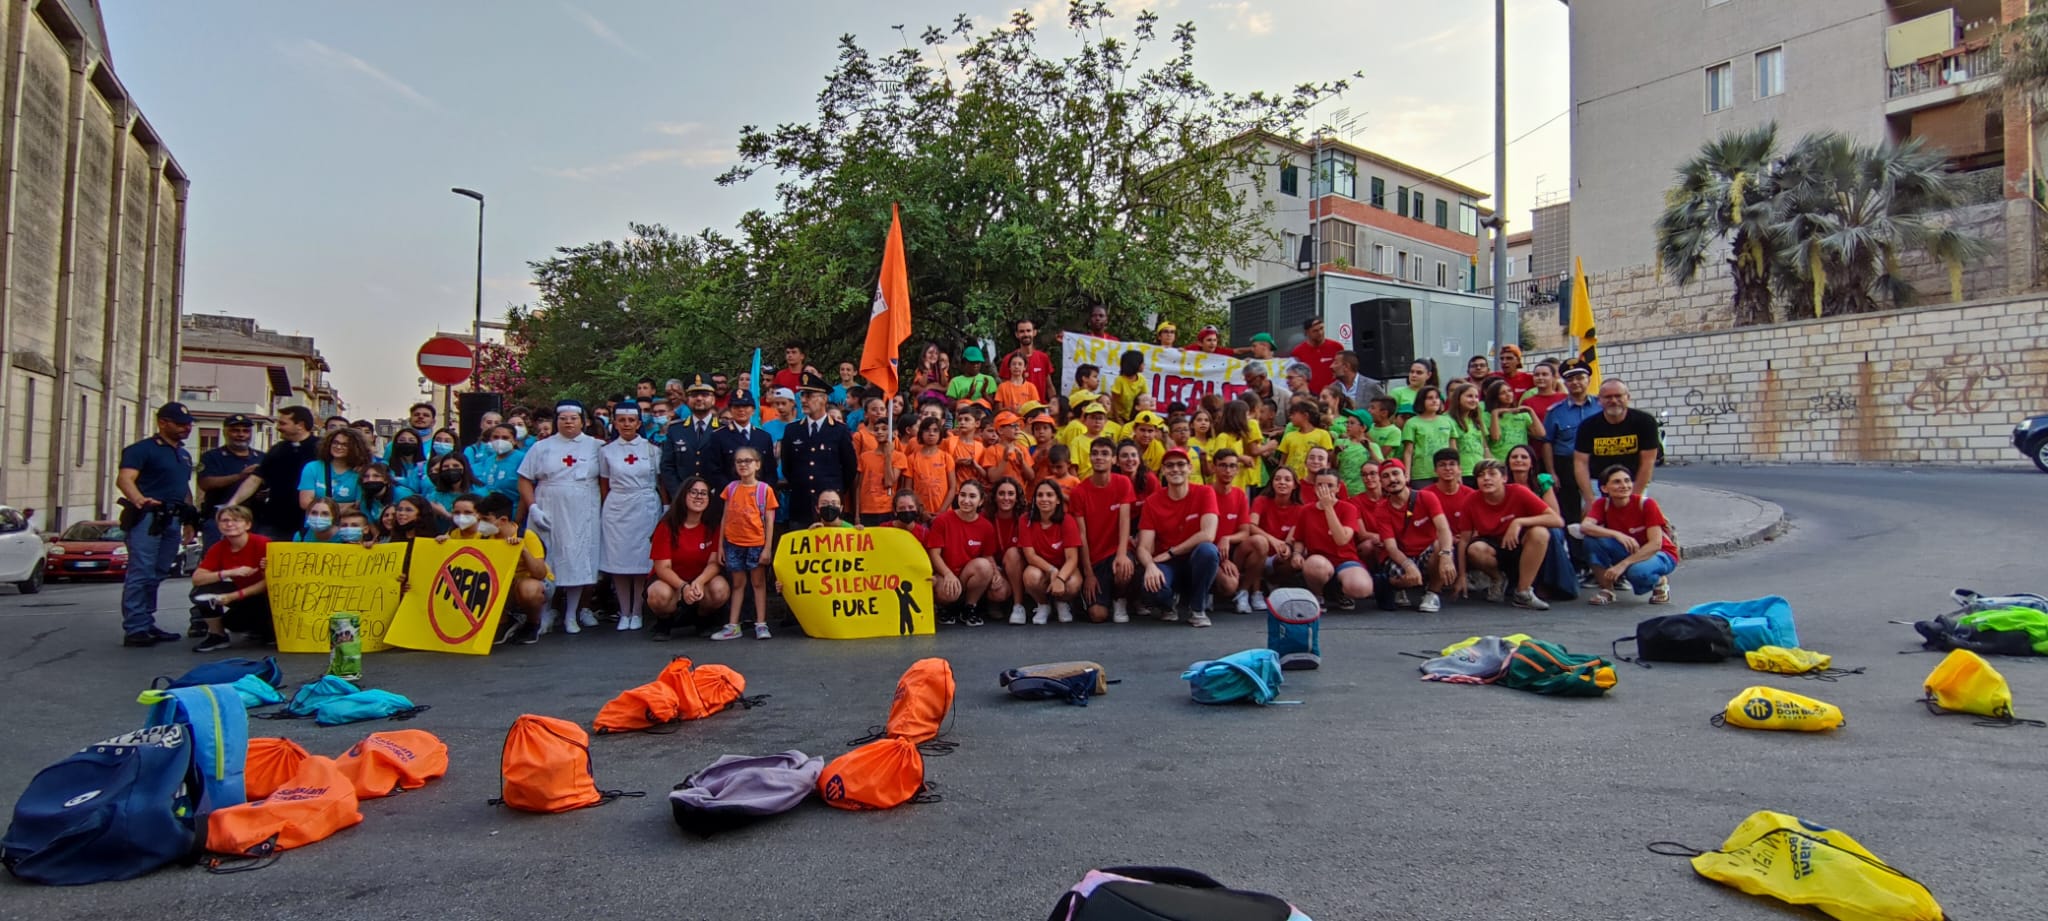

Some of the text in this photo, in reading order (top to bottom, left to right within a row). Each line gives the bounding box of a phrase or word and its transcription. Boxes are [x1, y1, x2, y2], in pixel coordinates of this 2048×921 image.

[1073, 337, 1287, 381] APRTE LE PTE
[790, 533, 874, 554] LA MAFIA
[271, 552, 291, 578] LA
[292, 552, 341, 578] PAURA
[795, 558, 865, 575] UCCIDE
[436, 564, 492, 619] MAFIA
[795, 575, 900, 596] IL SILENZIO
[832, 597, 879, 617] PURE
[312, 618, 385, 642] COGIO
